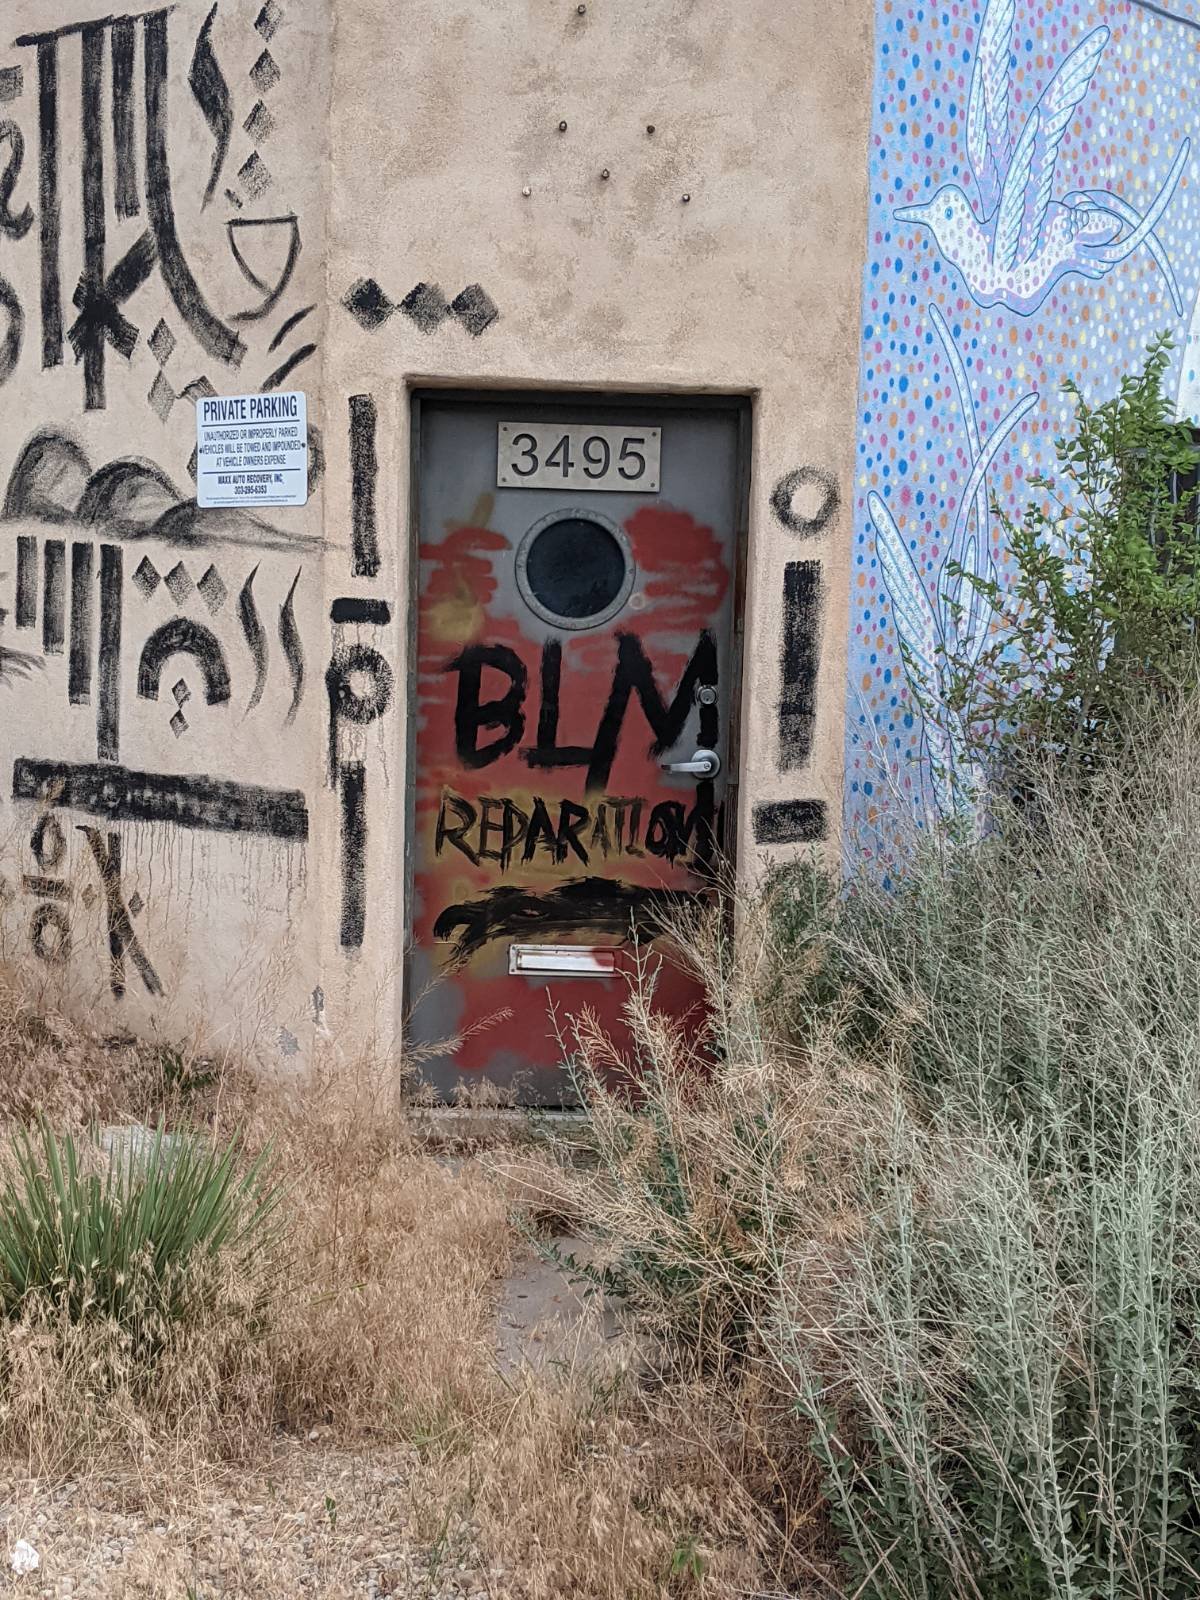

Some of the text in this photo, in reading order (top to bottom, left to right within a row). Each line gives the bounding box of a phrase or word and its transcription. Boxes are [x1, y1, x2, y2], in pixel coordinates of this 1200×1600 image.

[203, 395, 298, 421] PRIVATE PARKING
[204, 427, 298, 441] UNAUTHORIZED OR IMPROPERLY PARKED
[202, 441, 300, 454] VEHICLES WILL BE TOWED AND IMPOUNDED
[216, 458, 222, 467] AT
[223, 457, 242, 467] VEHICLE
[264, 455, 286, 465] EXPENSE
[510, 432, 647, 481] 3495
[217, 475, 231, 484] MAXX
[233, 475, 246, 484] AUTO
[449, 628, 719, 793] BLM
